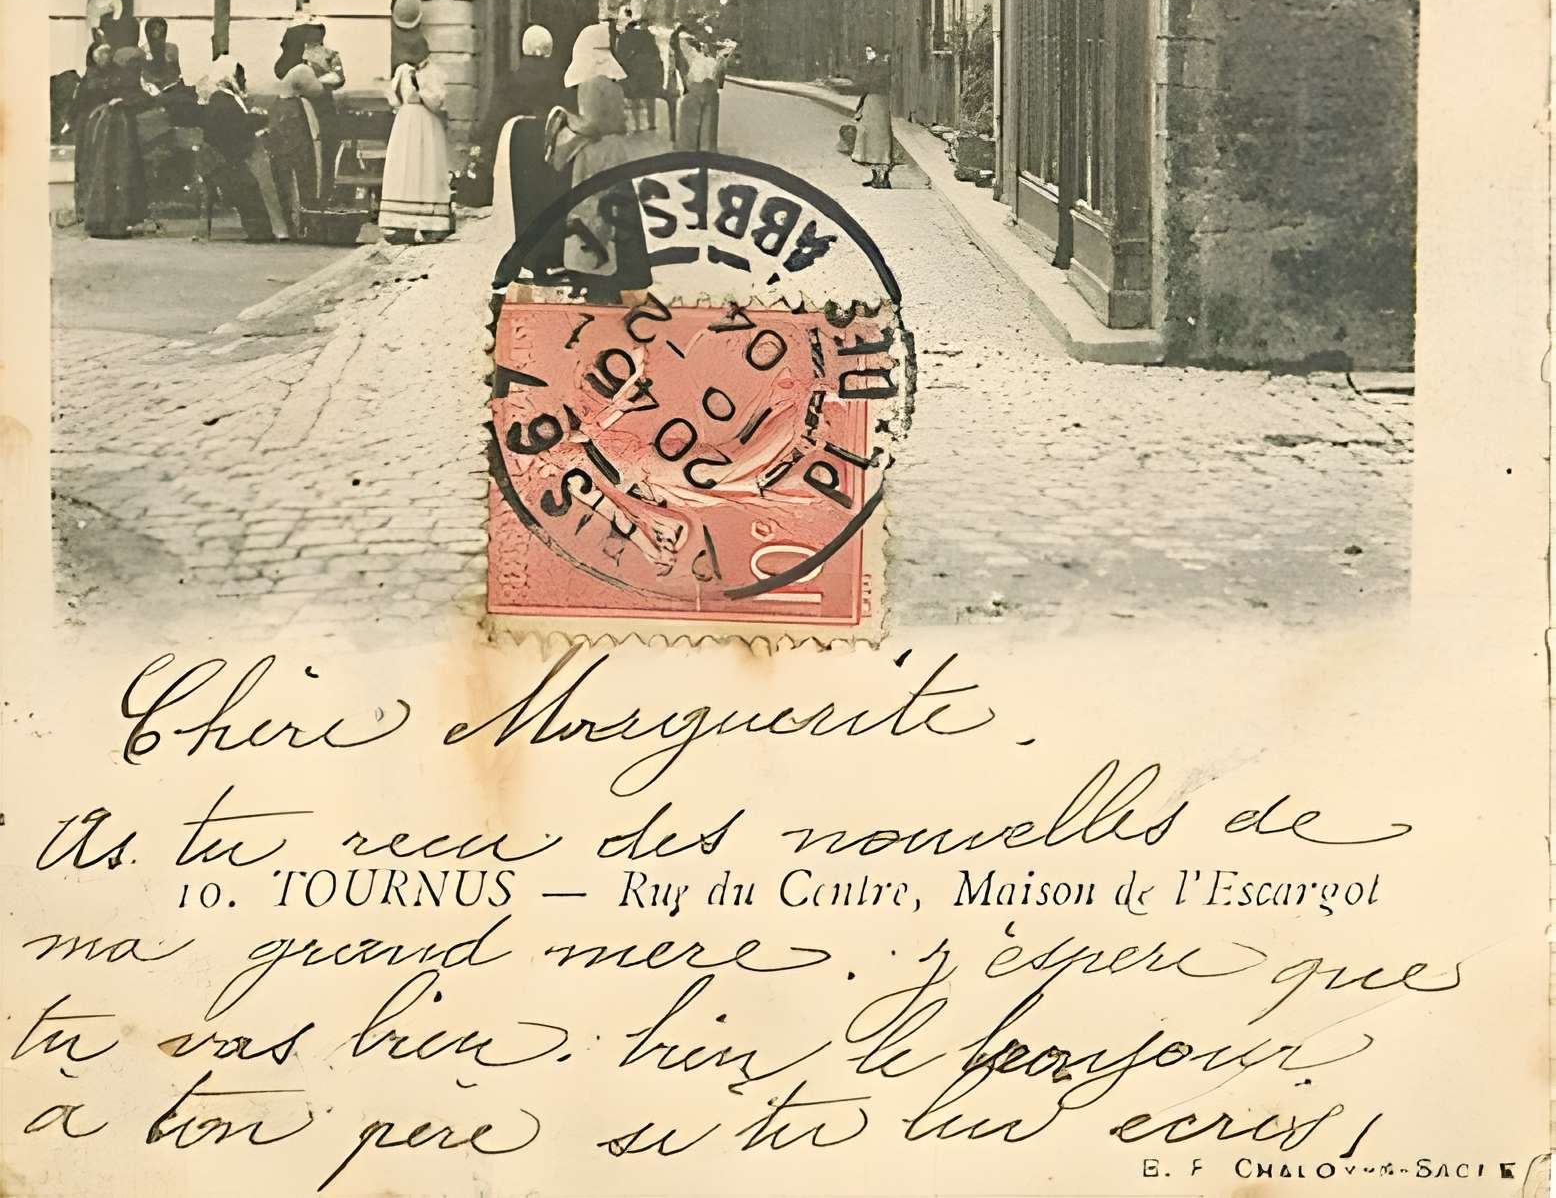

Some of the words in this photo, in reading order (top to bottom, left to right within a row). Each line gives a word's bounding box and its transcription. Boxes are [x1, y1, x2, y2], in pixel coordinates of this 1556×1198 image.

[175, 784, 314, 866] tu
[597, 801, 746, 860] des
[780, 758, 1190, 857] nouvelles
[1224, 794, 1412, 845] de
[21, 932, 196, 963] ma
[204, 913, 513, 1022] grand
[1271, 955, 1463, 1026] que
[158, 1021, 315, 1065] vas
[146, 1069, 315, 1148] ton
